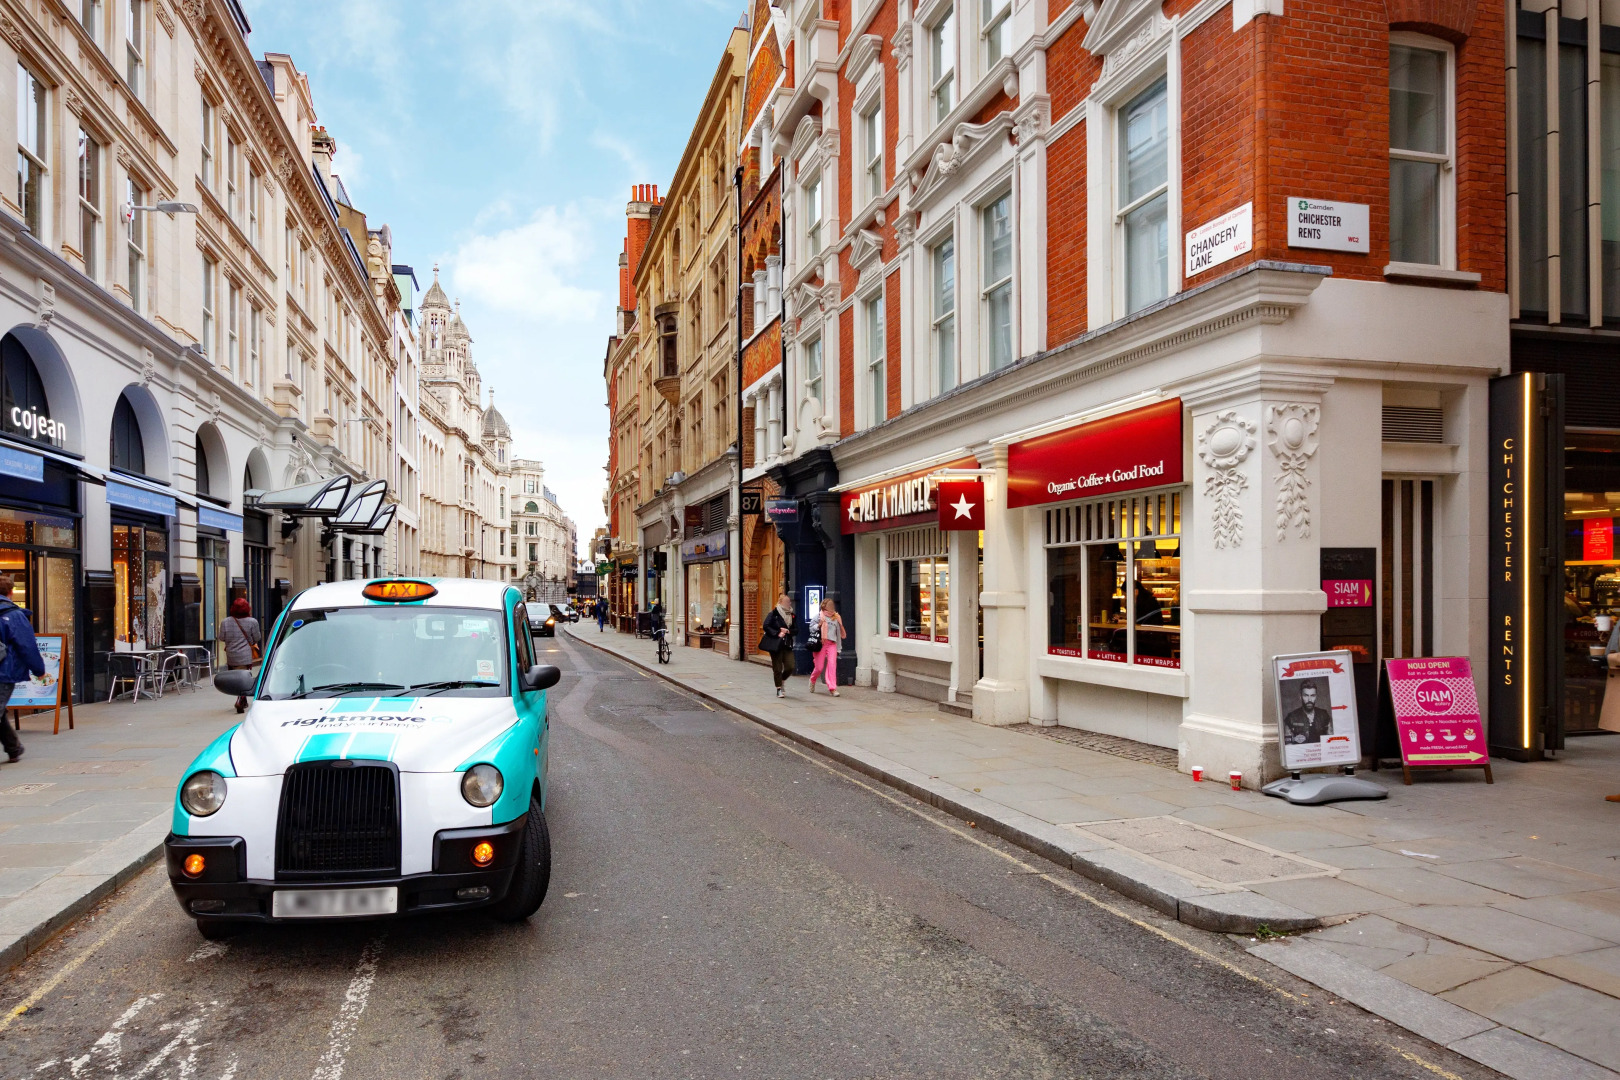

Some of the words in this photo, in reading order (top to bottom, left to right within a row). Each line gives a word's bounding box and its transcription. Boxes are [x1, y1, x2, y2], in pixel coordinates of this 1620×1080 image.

[1309, 203, 1334, 211] Camden
[1298, 212, 1342, 227] CHICHESTER
[1190, 223, 1238, 257] CHANCERY
[1298, 227, 1321, 240] RENTS
[1233, 241, 1247, 252] WC2
[1190, 251, 1213, 272] LANE
[11, 405, 66, 441] cojean
[1047, 478, 1077, 495] Organic
[1077, 472, 1104, 489] Coffee
[1112, 465, 1138, 483] Good
[1139, 460, 1164, 478] Food
[742, 496, 760, 511] 87
[859, 488, 880, 523] PRET
[881, 487, 889, 519] A
[890, 476, 932, 517] MANGER
[1503, 438, 1514, 582] CHICHESTER
[378, 584, 419, 598] TAXI
[1334, 582, 1359, 594] SIAM
[1056, 648, 1076, 656] TOASTIES
[1503, 615, 1514, 685] RENTS
[1143, 657, 1154, 665] HOT
[1155, 659, 1174, 667] WRAPS
[1428, 661, 1450, 669] OPEN!
[1417, 690, 1451, 703] SIAM
[280, 715, 427, 728] rightmove
[381, 721, 423, 729] happy
